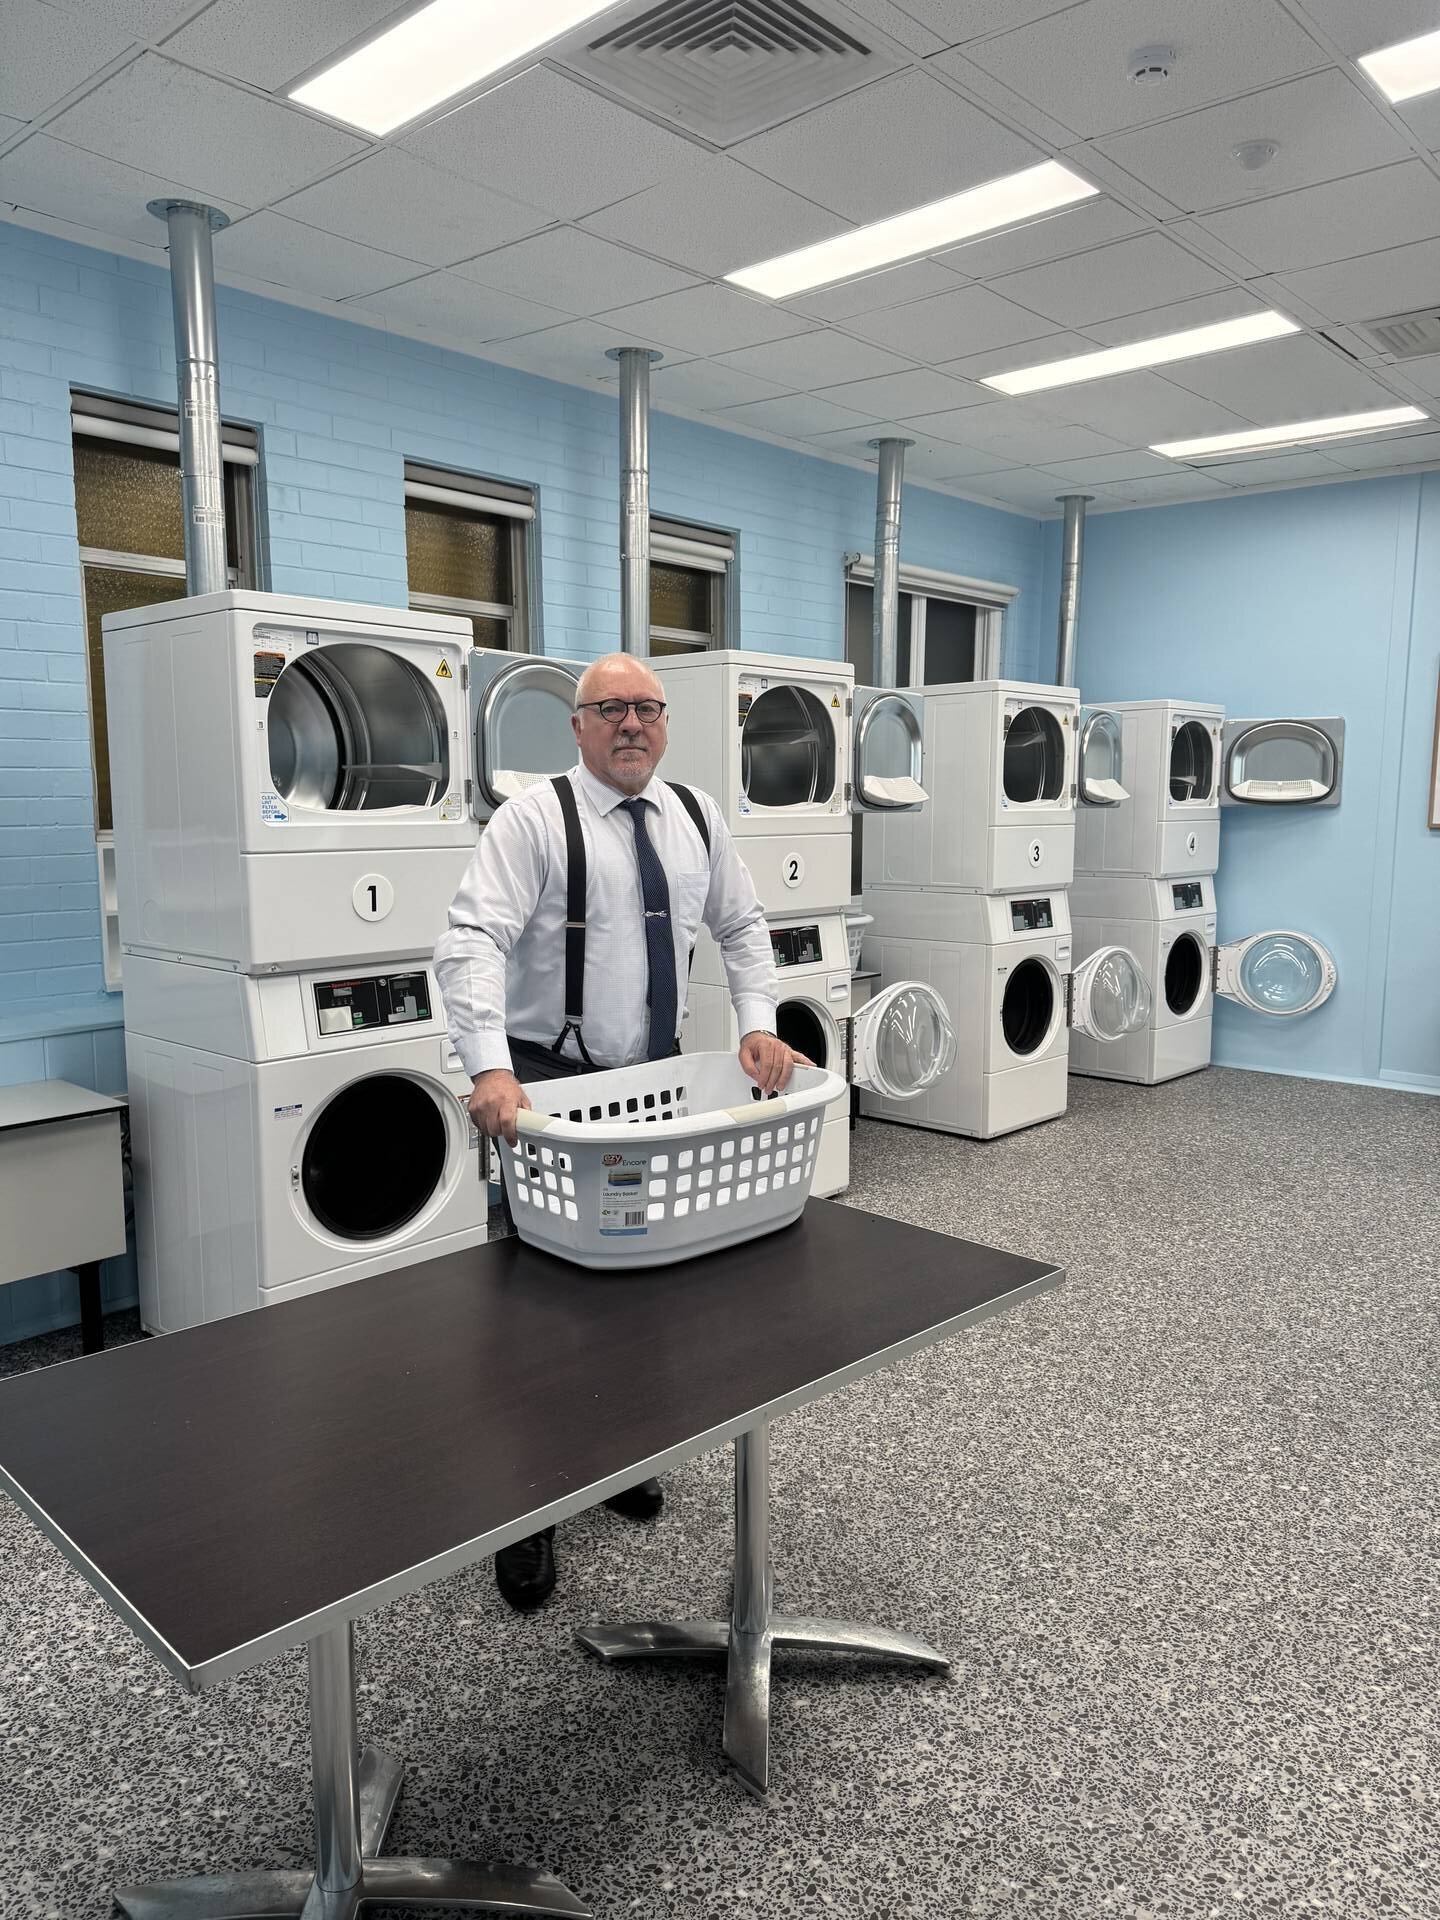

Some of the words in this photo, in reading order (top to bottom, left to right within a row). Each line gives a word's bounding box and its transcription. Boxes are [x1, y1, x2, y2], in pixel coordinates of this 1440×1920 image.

[1189, 837, 1195, 851] 4
[1033, 846, 1040, 862] 3
[788, 860, 798, 880] 2
[367, 885, 377, 912] 1
